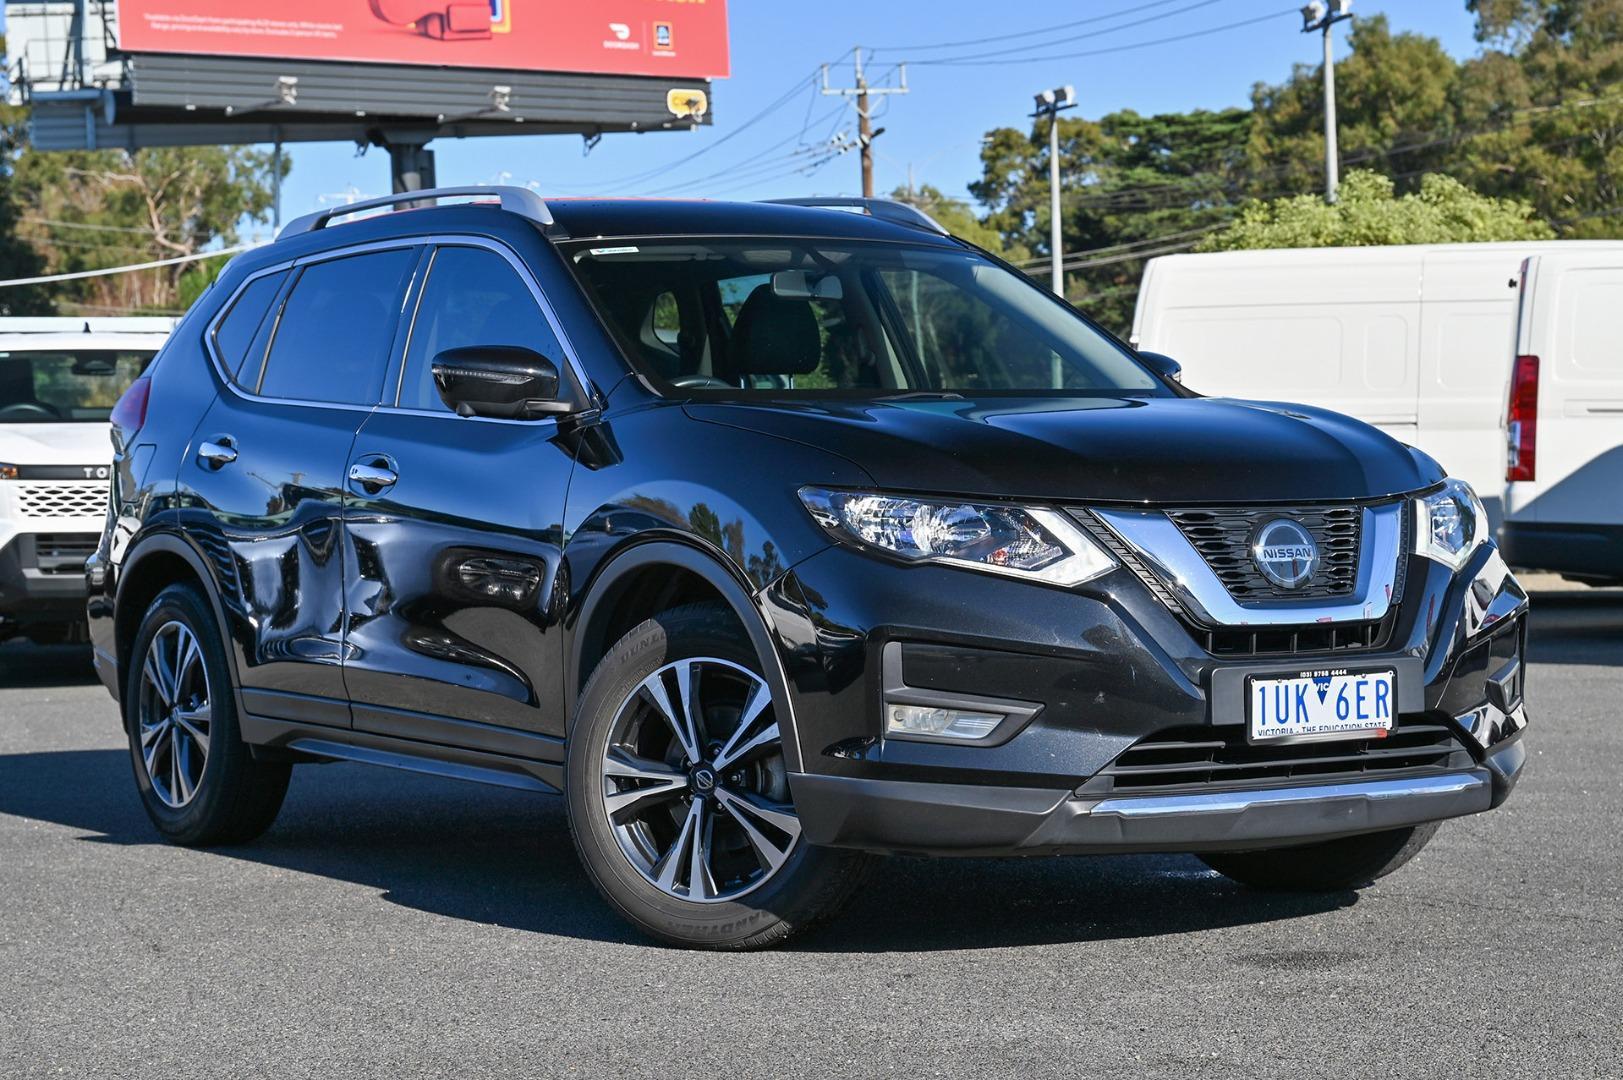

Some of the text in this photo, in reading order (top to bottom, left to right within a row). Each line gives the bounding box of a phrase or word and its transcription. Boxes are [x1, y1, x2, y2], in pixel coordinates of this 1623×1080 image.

[1263, 548, 1311, 559] NISSAN
[1316, 683, 1330, 692] VIC
[1258, 679, 1389, 726] 1UK 6ER
[1257, 728, 1294, 737] VICTORIA
